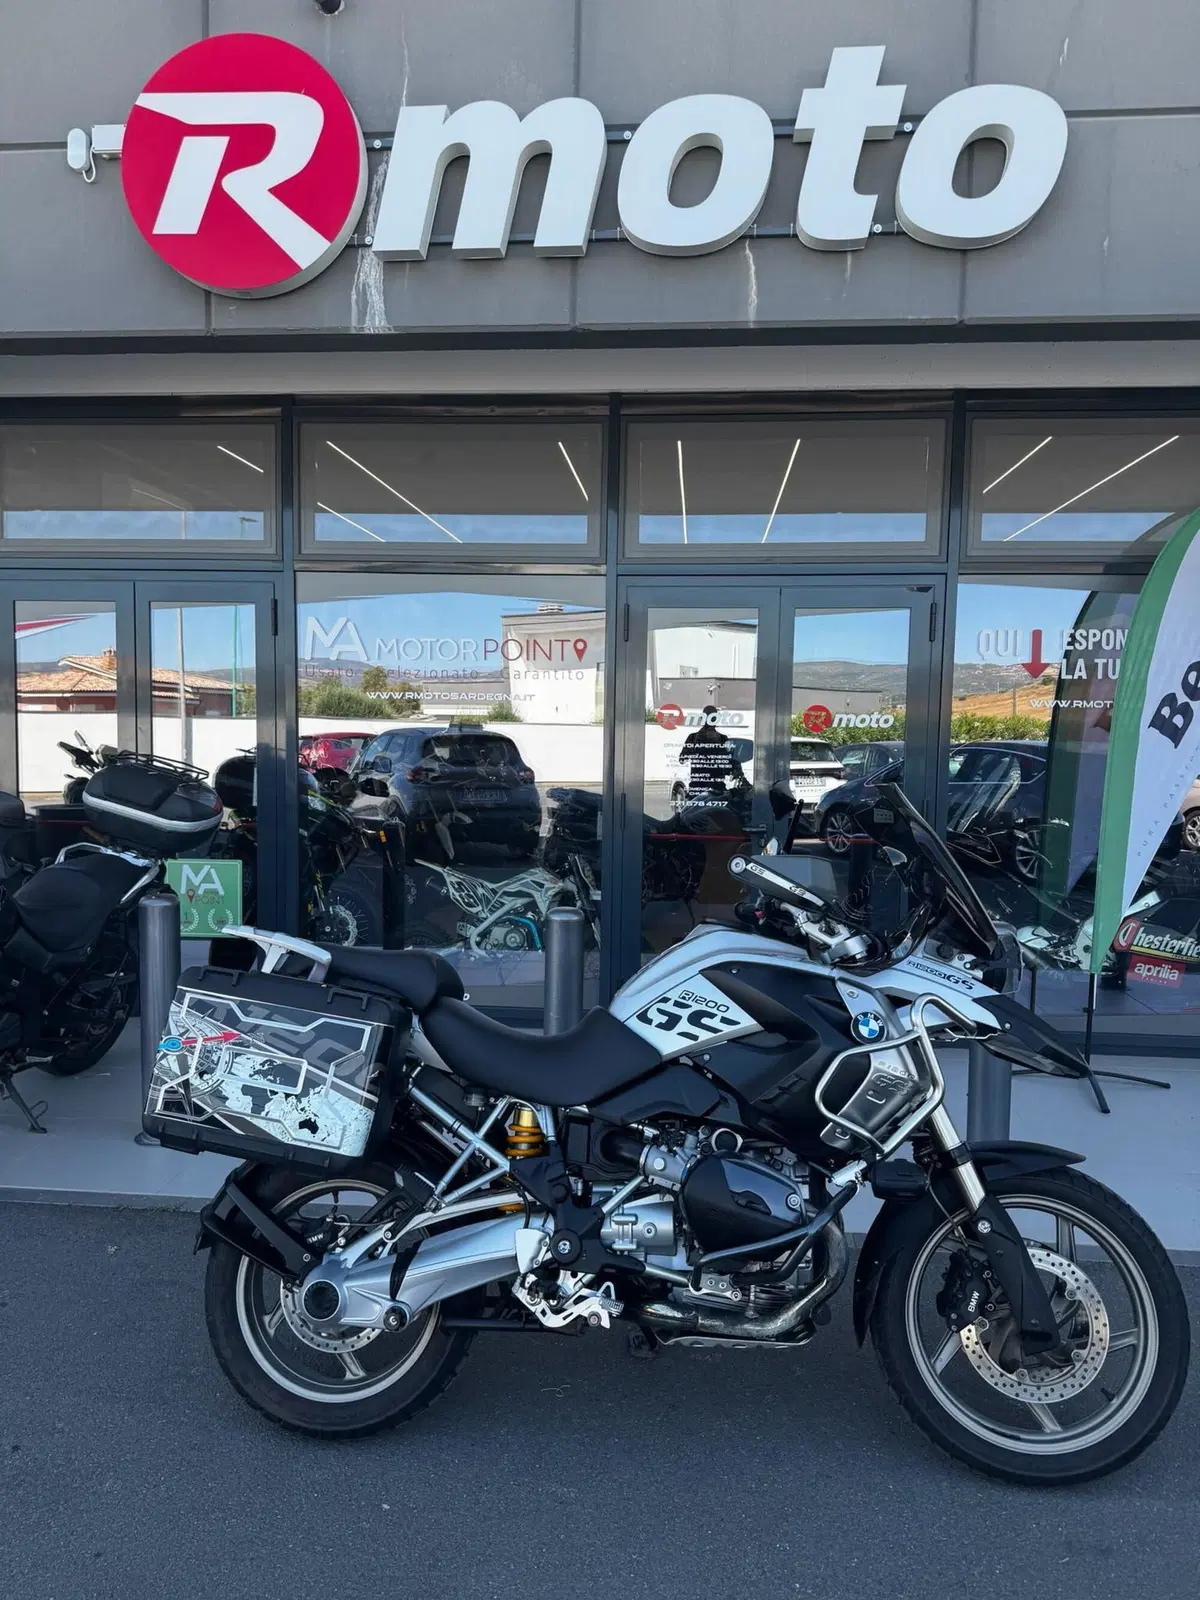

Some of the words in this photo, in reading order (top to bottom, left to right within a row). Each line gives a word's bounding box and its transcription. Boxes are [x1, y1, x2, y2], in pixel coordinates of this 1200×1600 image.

[371, 45, 1069, 261] moto
[976, 628, 1023, 660] QUI
[304, 664, 355, 678] Usato
[1060, 658, 1088, 680] LA
[832, 711, 896, 728] moto
[1134, 962, 1180, 981] aprilia
[678, 989, 730, 1014] R1200
[967, 1291, 980, 1313] BMW
